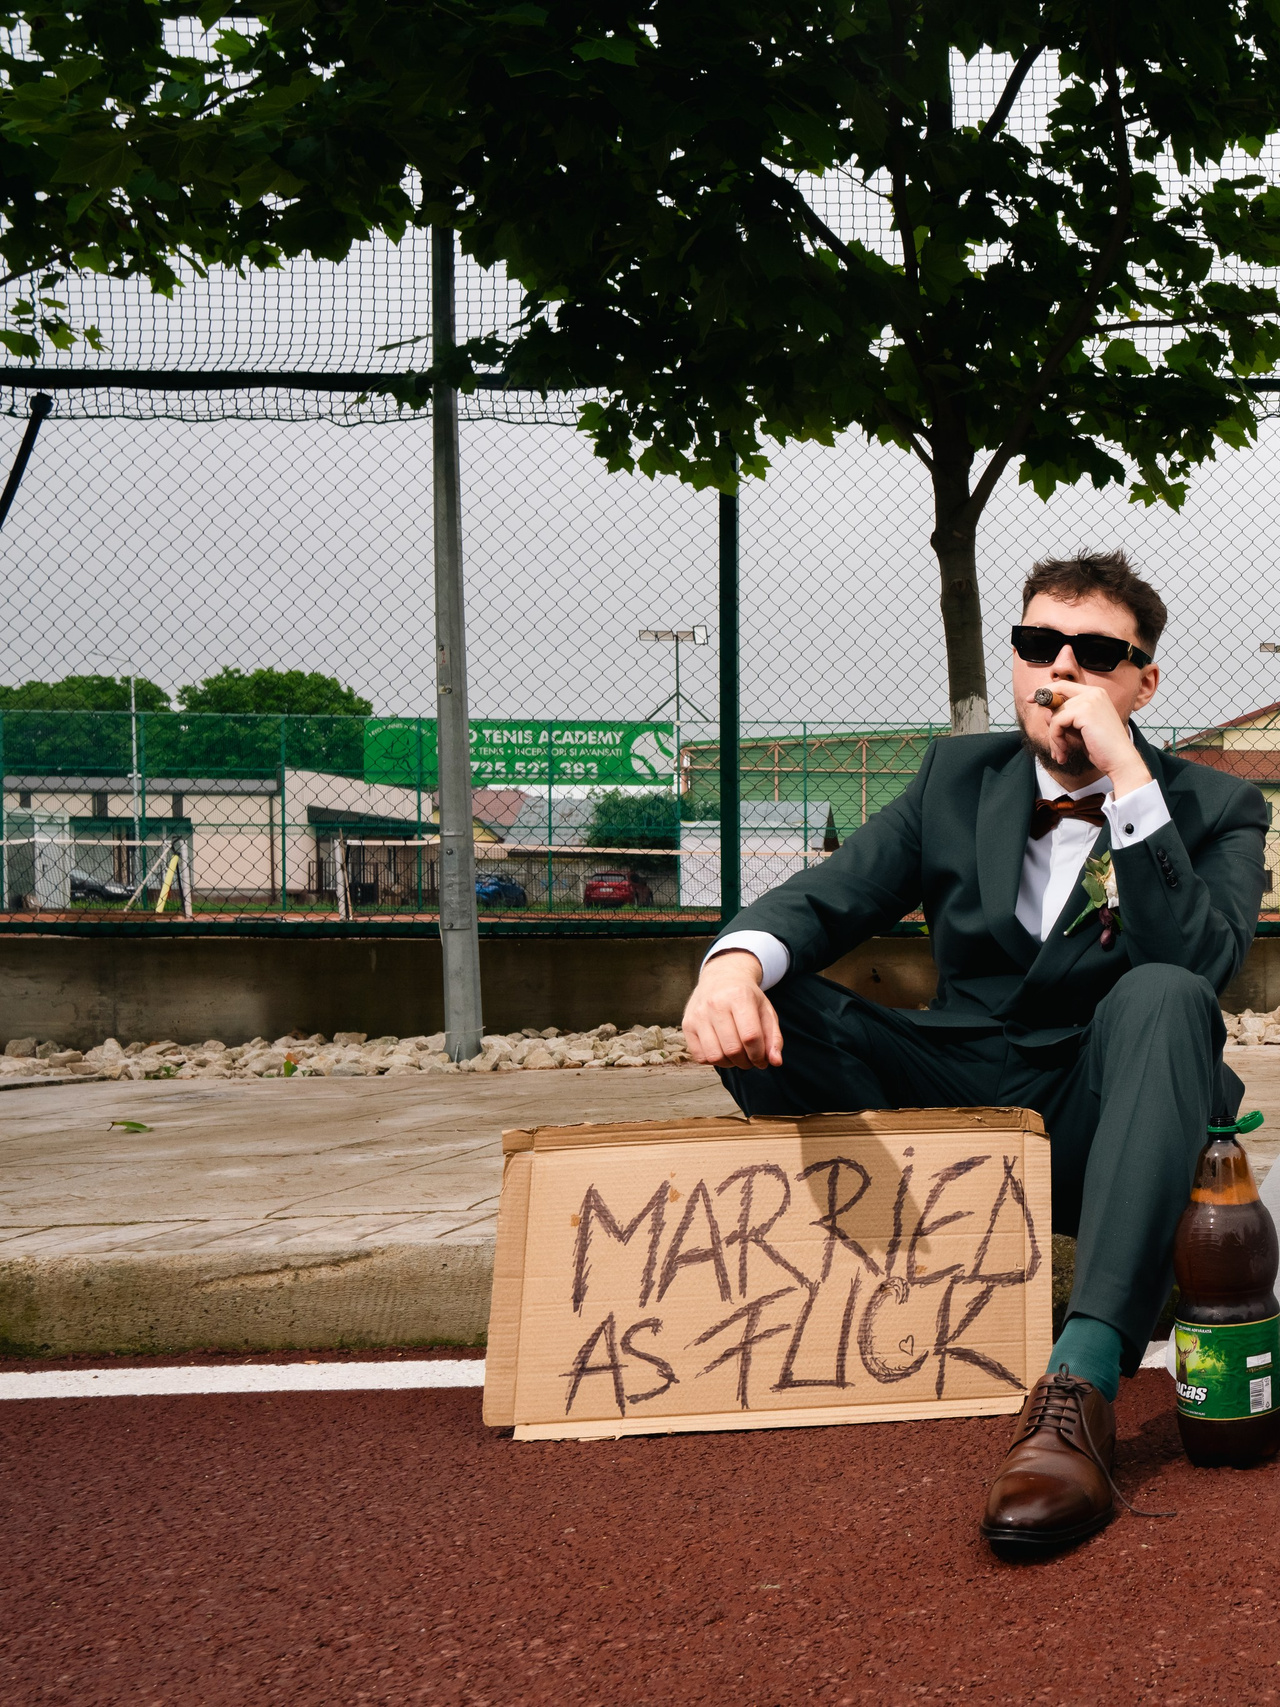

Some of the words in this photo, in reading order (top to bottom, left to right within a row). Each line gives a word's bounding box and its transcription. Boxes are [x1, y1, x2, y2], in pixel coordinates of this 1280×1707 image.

[482, 729, 533, 744] TENIS
[538, 730, 624, 745] ACADEMY
[479, 747, 504, 756] TENIS
[559, 1311, 680, 1417] AS
